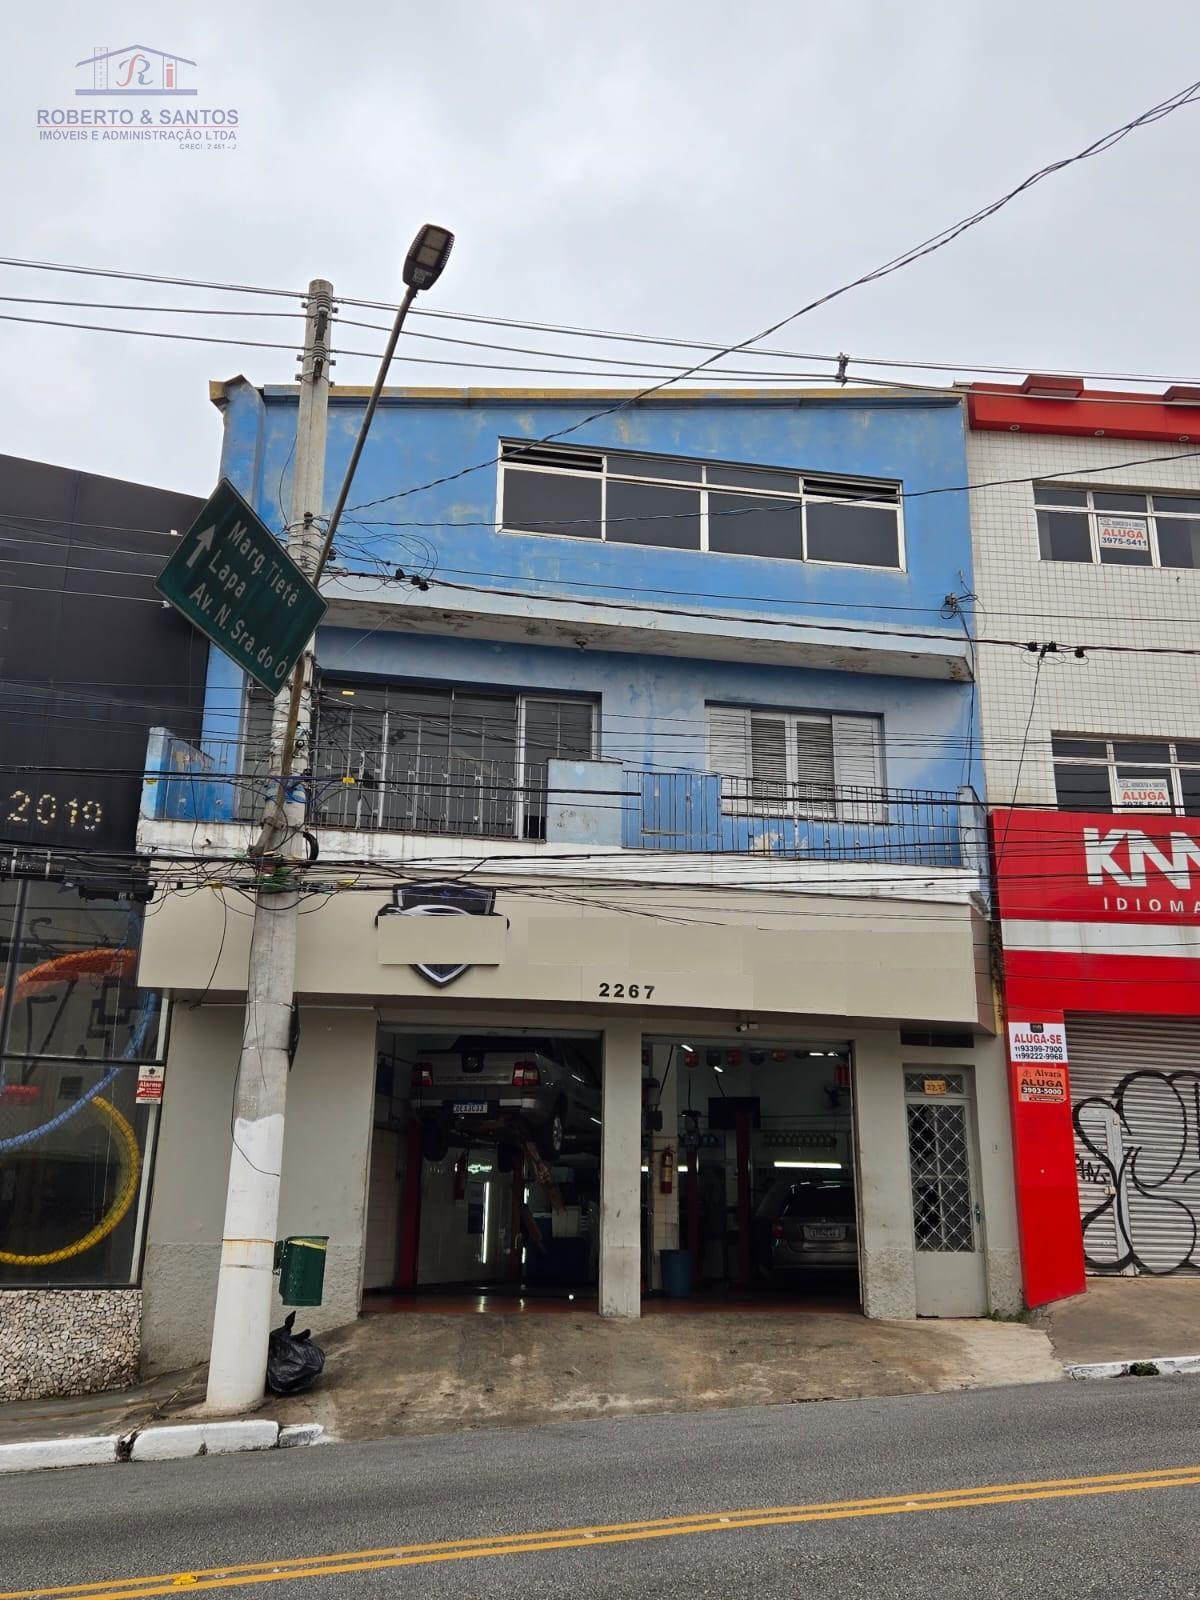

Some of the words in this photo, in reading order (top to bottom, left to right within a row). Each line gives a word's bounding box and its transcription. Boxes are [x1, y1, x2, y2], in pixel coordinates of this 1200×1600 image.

[1103, 528, 1144, 540] ALUGA
[227, 519, 264, 576] Marg.
[1102, 537, 1147, 546] 3975-5411
[208, 550, 248, 599] Lapa
[189, 582, 214, 616] Av.
[213, 603, 233, 630] N.
[230, 619, 255, 657] Sra.
[256, 646, 274, 670] do
[274, 655, 289, 679] Ó
[1122, 791, 1167, 801] ALUGA
[598, 982, 655, 999] 2267
[1021, 1078, 1063, 1087] ALUGA
